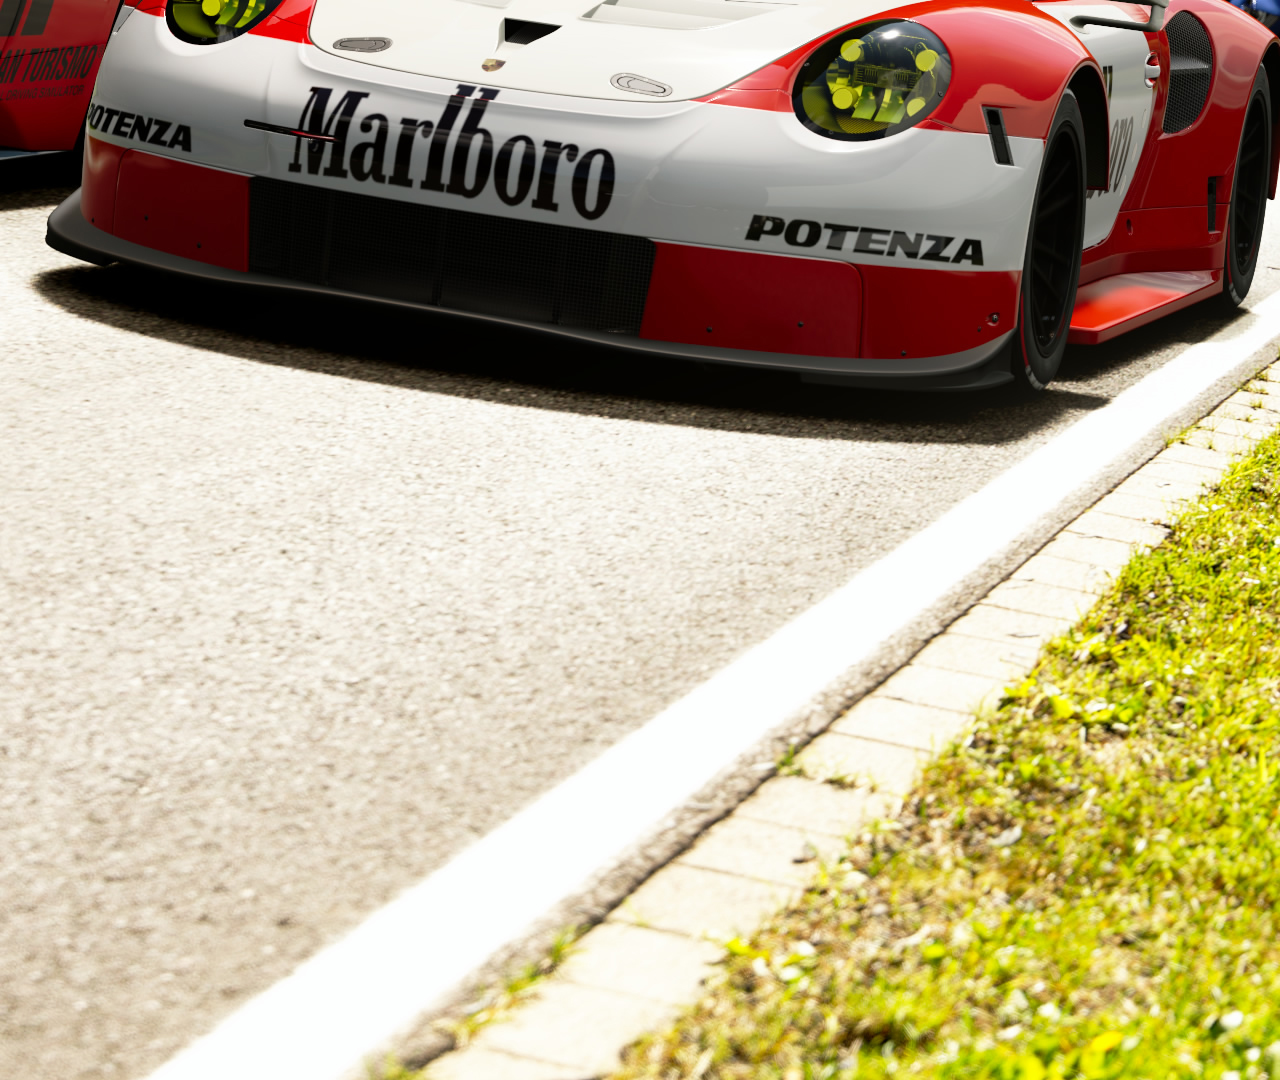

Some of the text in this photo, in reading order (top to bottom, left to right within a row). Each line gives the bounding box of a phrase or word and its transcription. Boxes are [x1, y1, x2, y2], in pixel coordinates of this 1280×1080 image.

[21, 44, 99, 82] TURISMO
[5, 87, 38, 101] DRIVING
[38, 85, 85, 99] SIMULATOR
[87, 103, 192, 152] OTENZA
[288, 83, 616, 221] Marlboro
[744, 214, 984, 267] POTENZA
